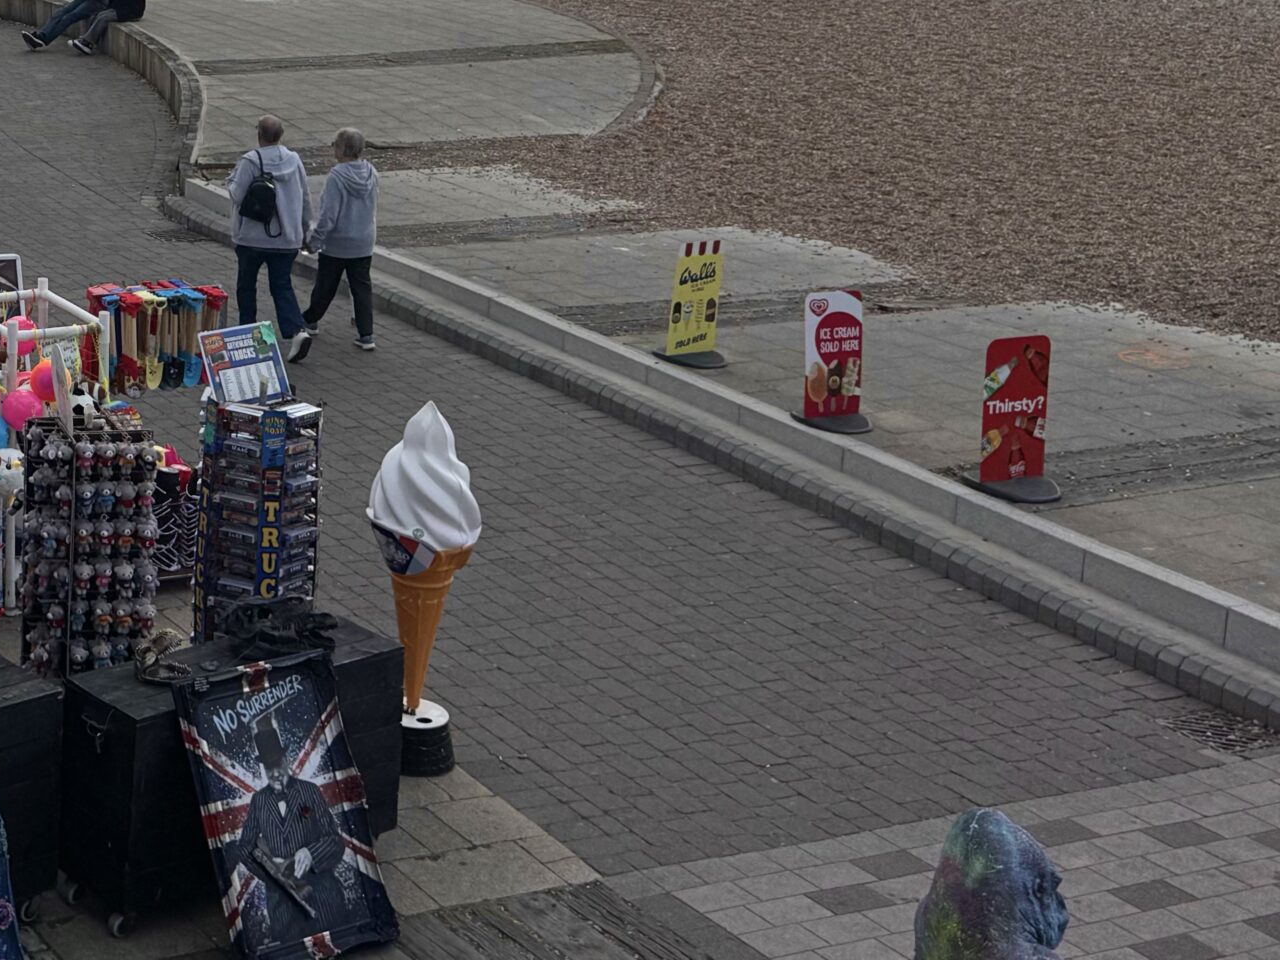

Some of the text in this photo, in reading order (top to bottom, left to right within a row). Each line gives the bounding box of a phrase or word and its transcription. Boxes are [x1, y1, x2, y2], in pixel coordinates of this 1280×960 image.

[675, 333, 707, 349] SOLD HERE
[820, 326, 860, 339] ICE CREAM
[230, 347, 256, 361] TRUCKS
[820, 339, 860, 353] SOLD HERE
[986, 396, 1044, 414] Thirsty?
[258, 500, 281, 598] TRUC
[195, 487, 210, 633] TRUCKS
[212, 674, 303, 744] NO SURRENDER
